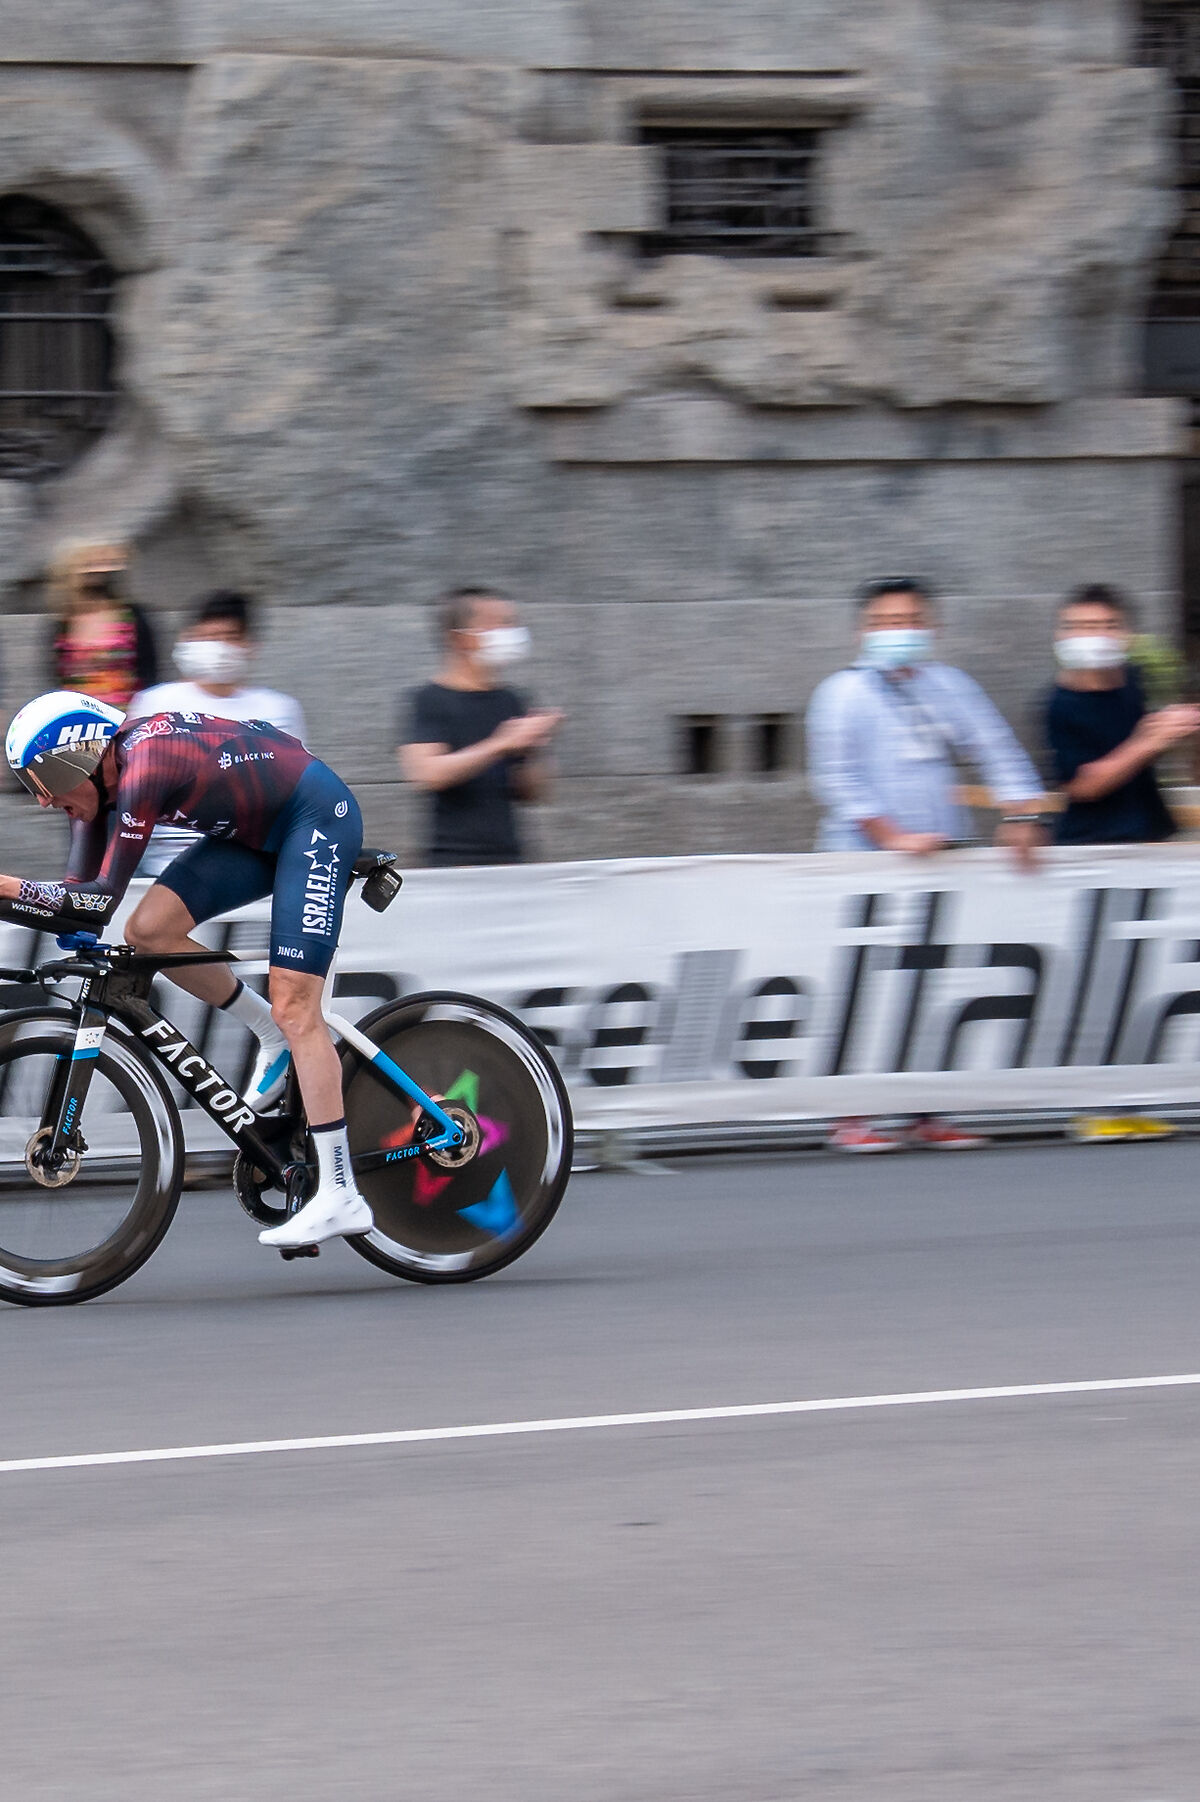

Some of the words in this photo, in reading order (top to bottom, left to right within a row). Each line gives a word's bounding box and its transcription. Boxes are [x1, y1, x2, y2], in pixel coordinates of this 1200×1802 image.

[57, 723, 113, 745] HJC
[234, 752, 260, 764] BLACK
[261, 751, 275, 760] INC
[11, 902, 54, 917] WATTSHOP
[302, 873, 332, 935] ISRAEL
[277, 946, 304, 959] JINGA
[142, 1020, 255, 1133] FACTOR
[62, 1097, 78, 1135] FACTOR
[386, 1146, 420, 1162] FACTOR
